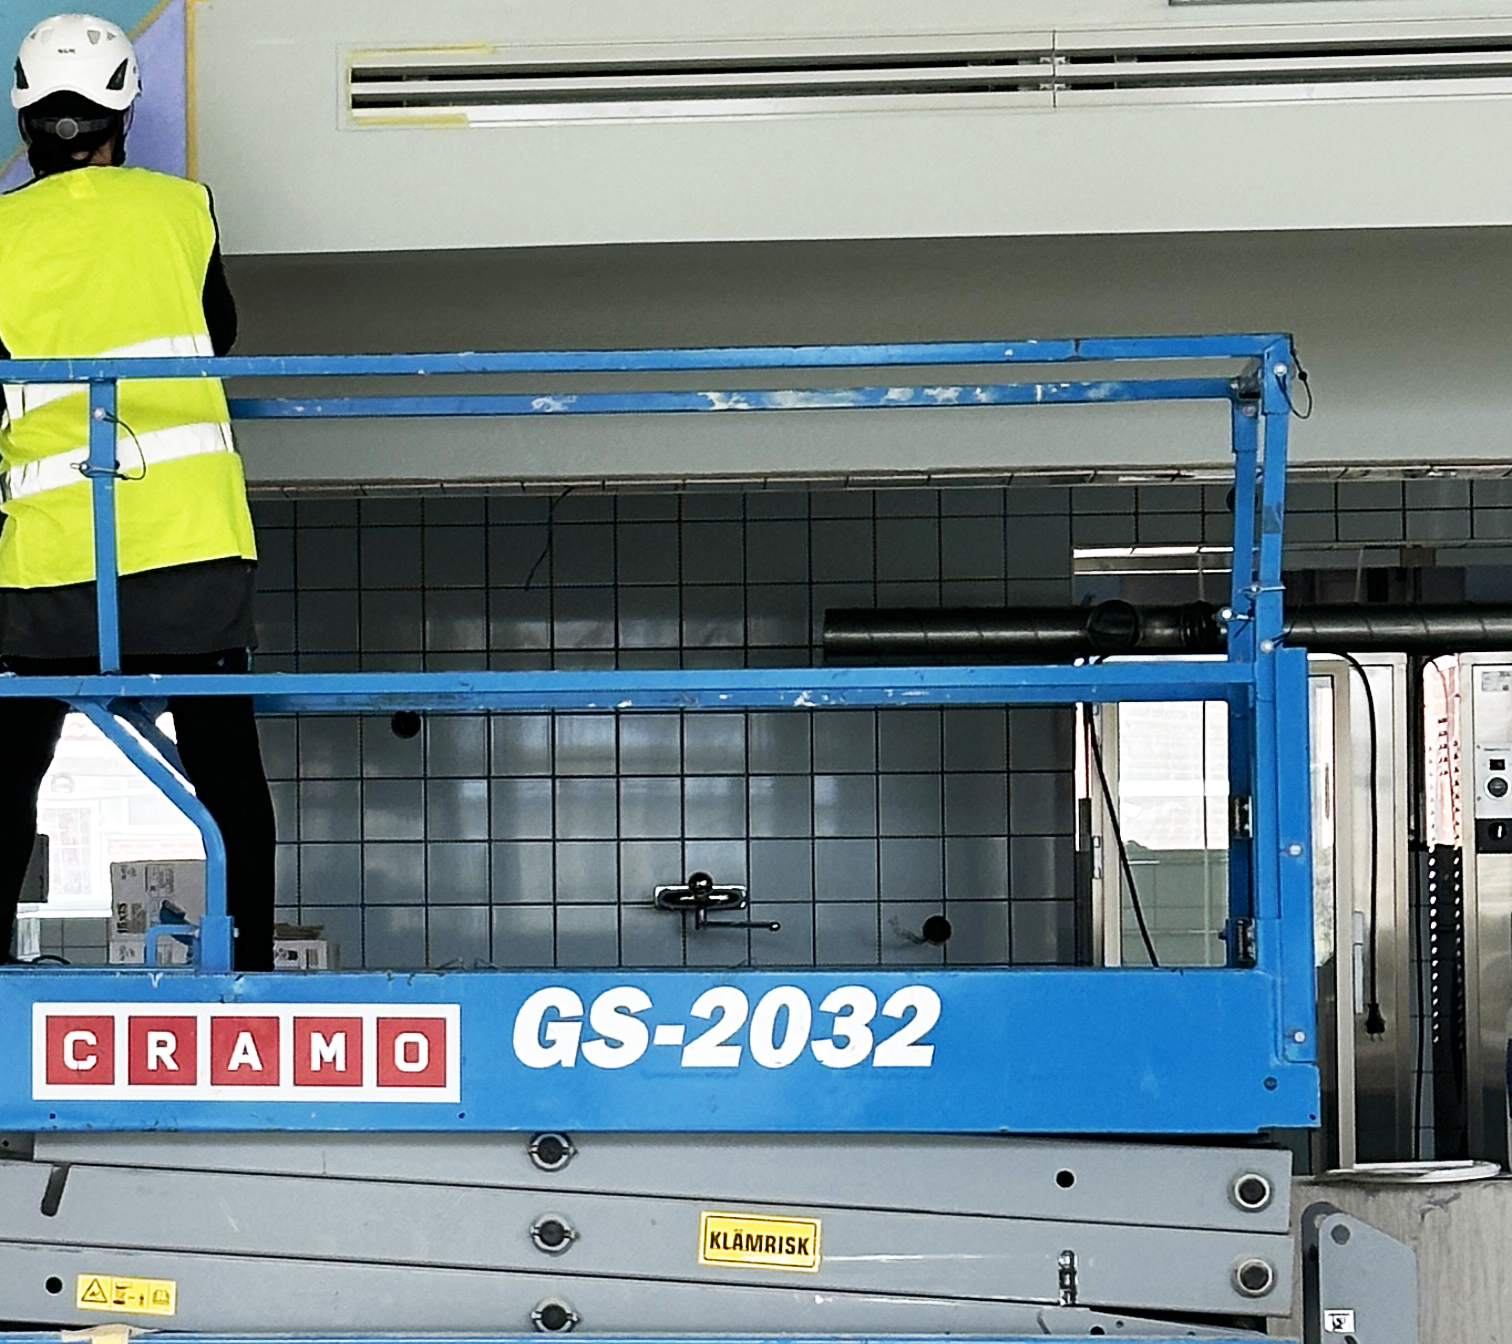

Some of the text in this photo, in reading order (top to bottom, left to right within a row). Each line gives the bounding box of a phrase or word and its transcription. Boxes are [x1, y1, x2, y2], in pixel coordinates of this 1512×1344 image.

[513, 986, 941, 1069] GS-2032
[63, 1030, 430, 1073] CRAMO
[710, 1228, 809, 1256] KLÄMRISK
